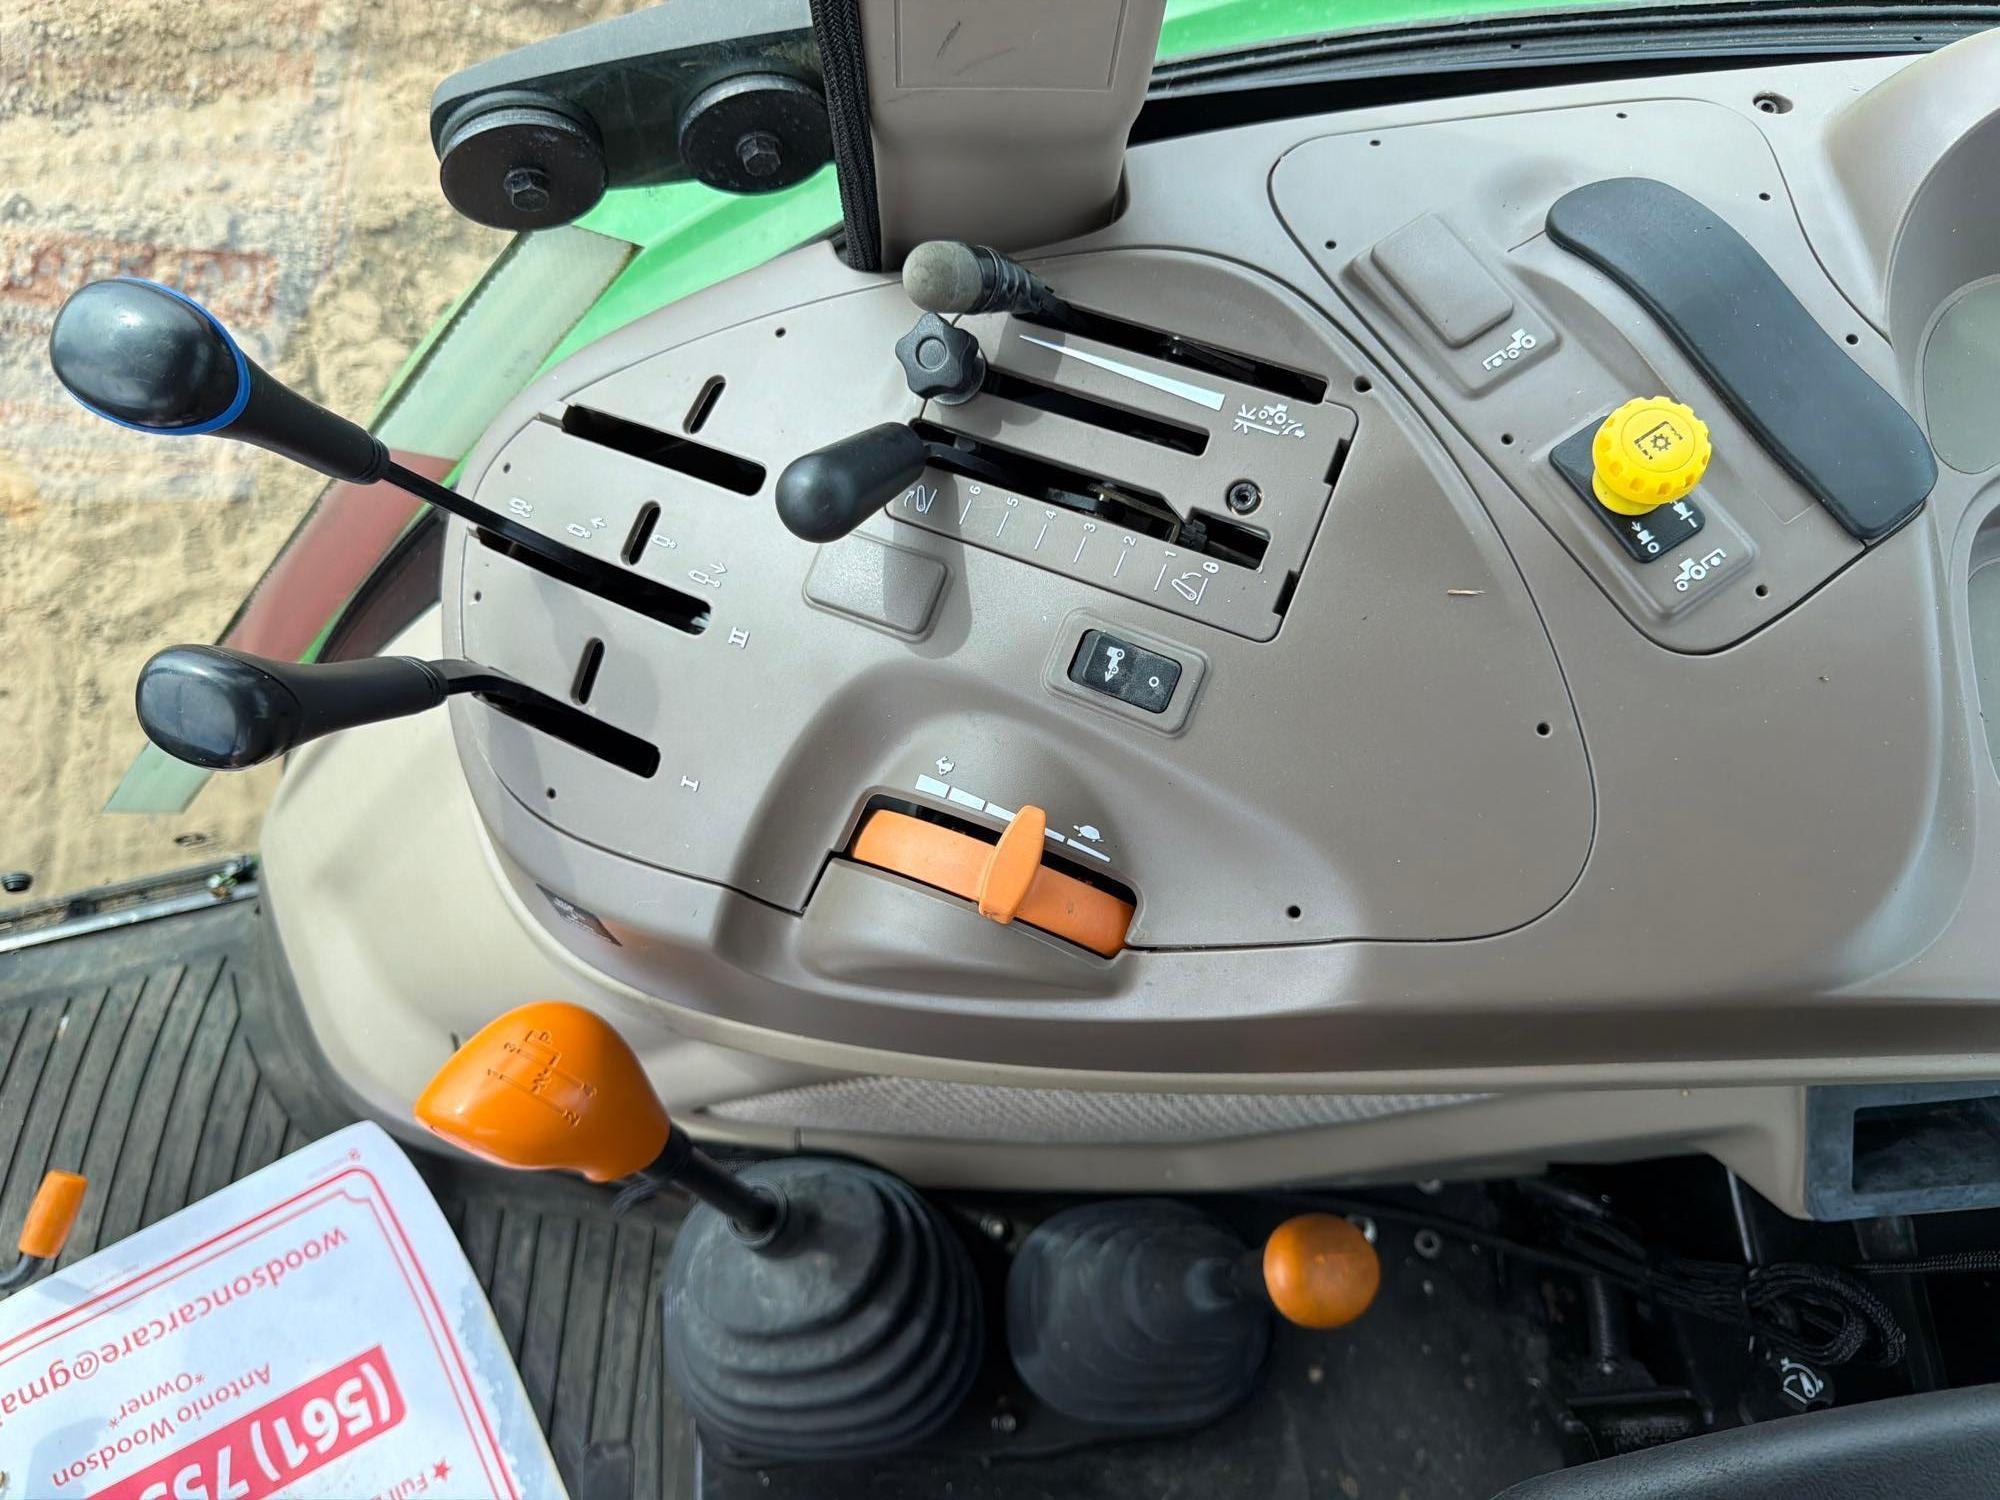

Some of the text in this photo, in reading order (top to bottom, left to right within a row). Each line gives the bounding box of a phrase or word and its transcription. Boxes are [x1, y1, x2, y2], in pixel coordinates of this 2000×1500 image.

[969, 485, 981, 495] 6
[1006, 497, 1019, 508] 5
[1045, 509, 1057, 520] 4
[1083, 522, 1096, 533] 3
[1123, 535, 1137, 546] 2
[0, 1227, 349, 1426] woodsoncarcare@gma
[52, 1363, 272, 1488] Antonio Woodson
[251, 1362, 391, 1482] (561)
